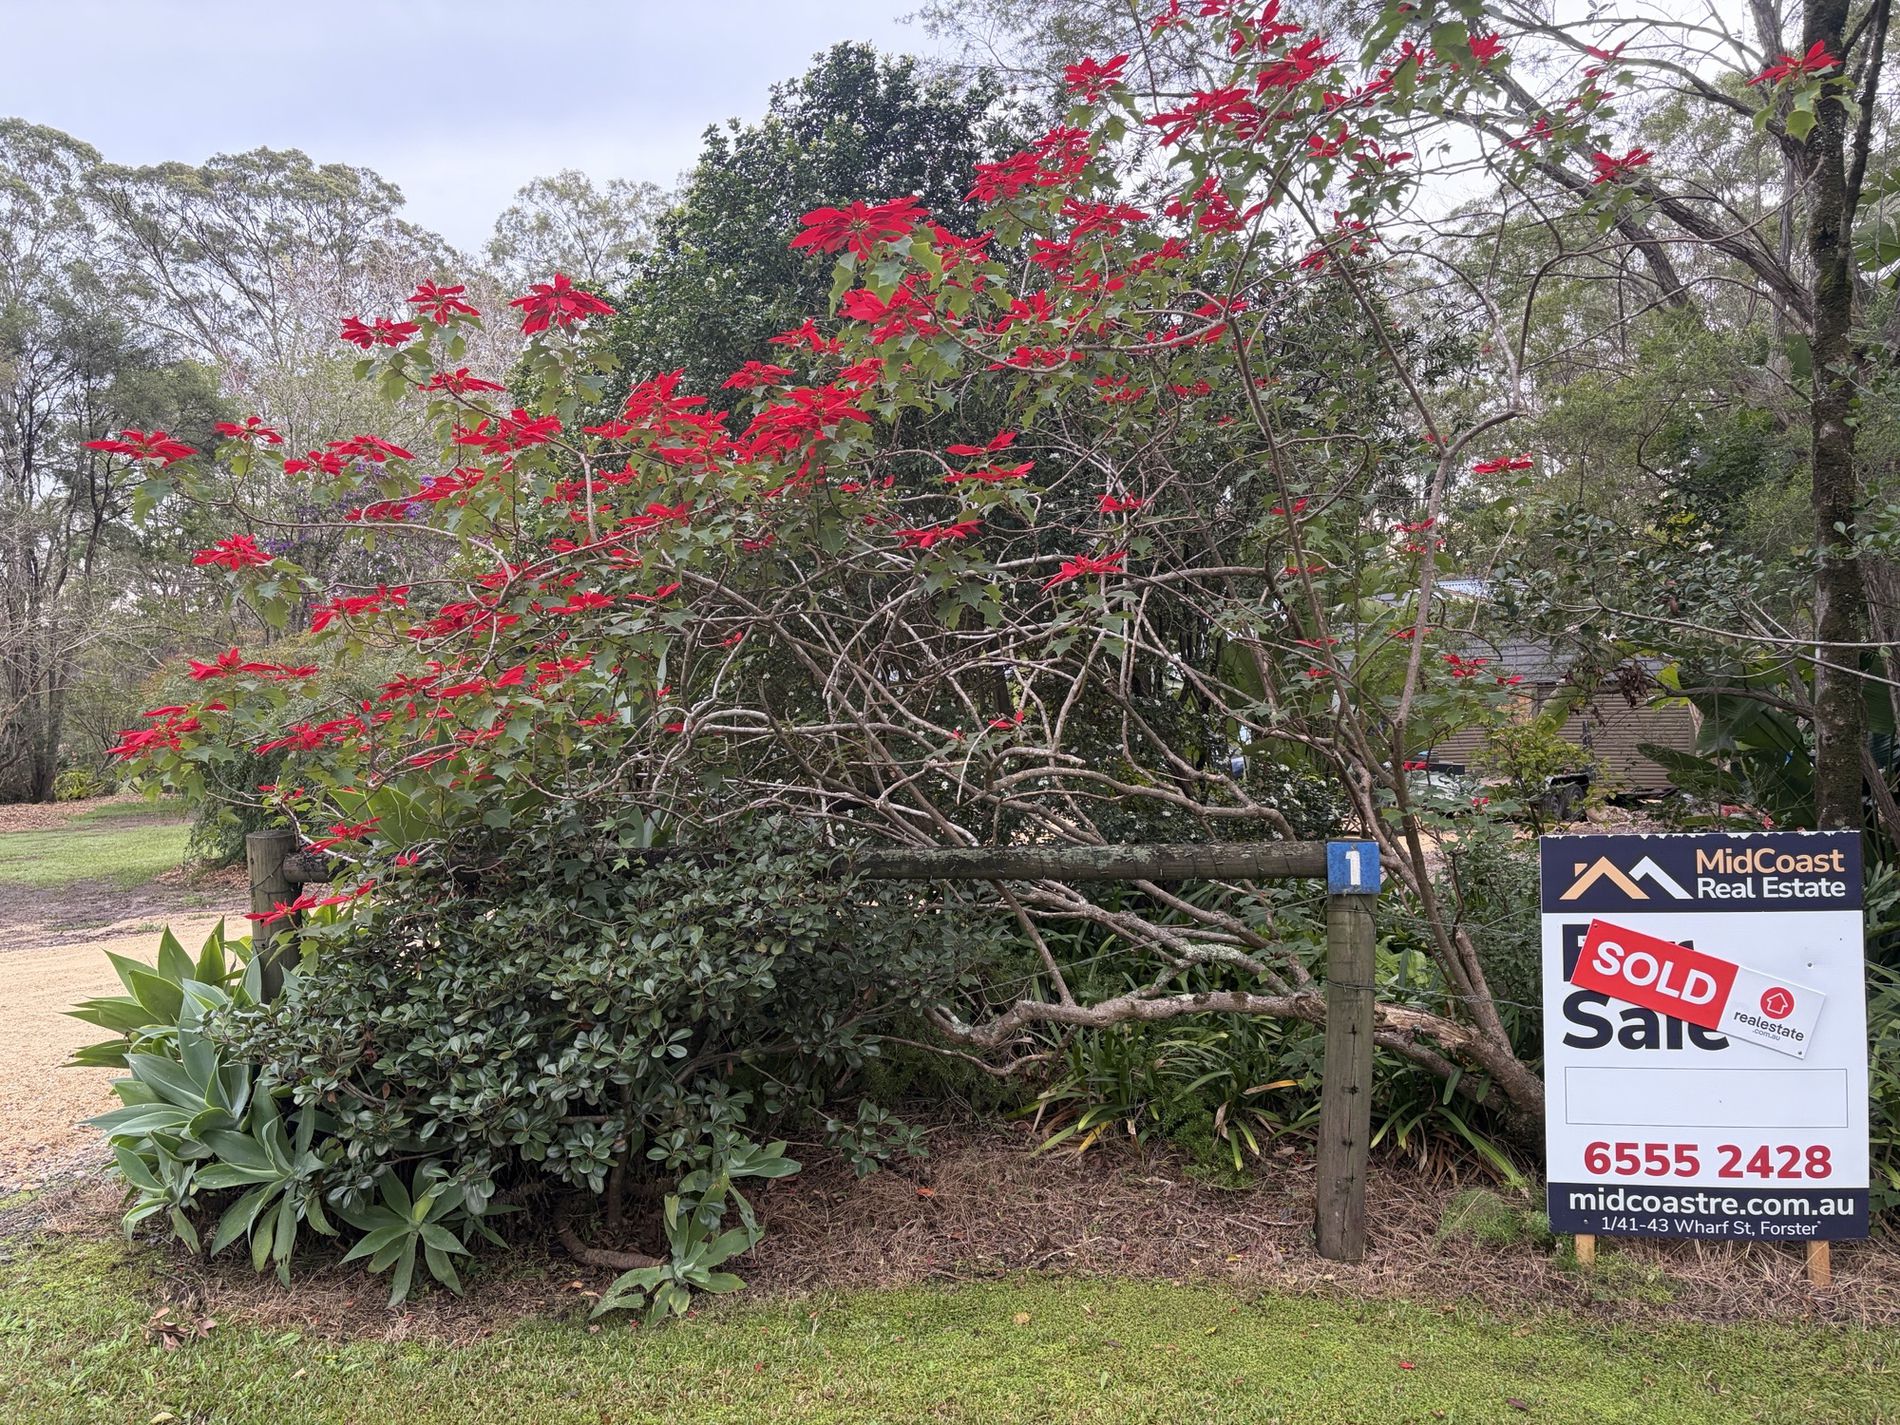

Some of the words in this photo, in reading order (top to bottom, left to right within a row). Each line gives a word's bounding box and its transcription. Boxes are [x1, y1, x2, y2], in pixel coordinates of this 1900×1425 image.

[1345, 850, 1361, 886] 1
[1696, 847, 1846, 875] MidCoast
[1697, 876, 1757, 899] Real
[1763, 876, 1846, 899] Estate
[1592, 941, 1718, 1006] SOLD
[1733, 1011, 1805, 1042] realestate
[1752, 1028, 1781, 1041] .com.au
[1584, 1141, 1701, 1178] 6555
[1716, 1144, 1833, 1179] 2428
[1569, 1186, 1855, 1217] midcoastre.com.au
[1601, 1216, 1669, 1233] 1/41-43
[1674, 1217, 1730, 1235] Wharf
[1736, 1219, 1756, 1237] St,
[1761, 1220, 1819, 1236] Forster
